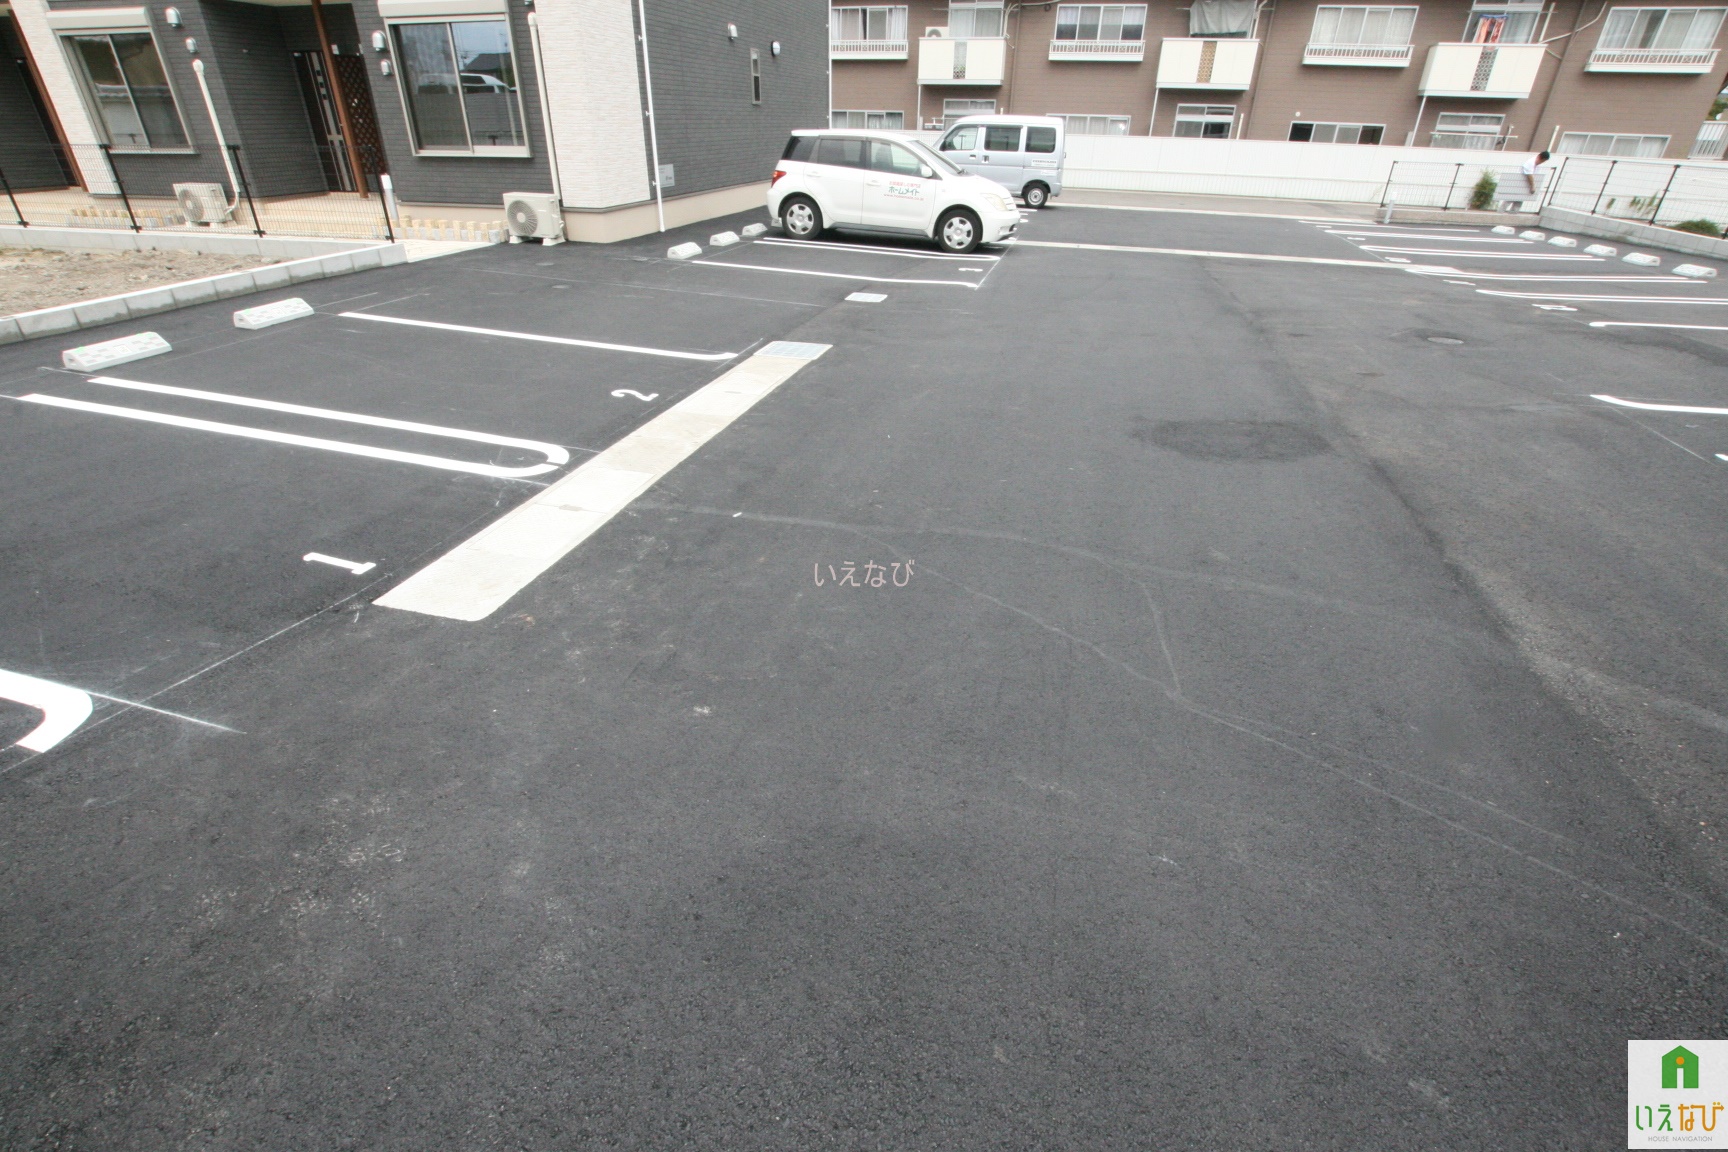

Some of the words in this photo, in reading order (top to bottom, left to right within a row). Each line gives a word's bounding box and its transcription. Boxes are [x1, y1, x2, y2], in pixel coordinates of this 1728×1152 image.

[888, 186, 920, 196] ホームメイト
[611, 389, 659, 401] 2
[302, 552, 376, 575] 1
